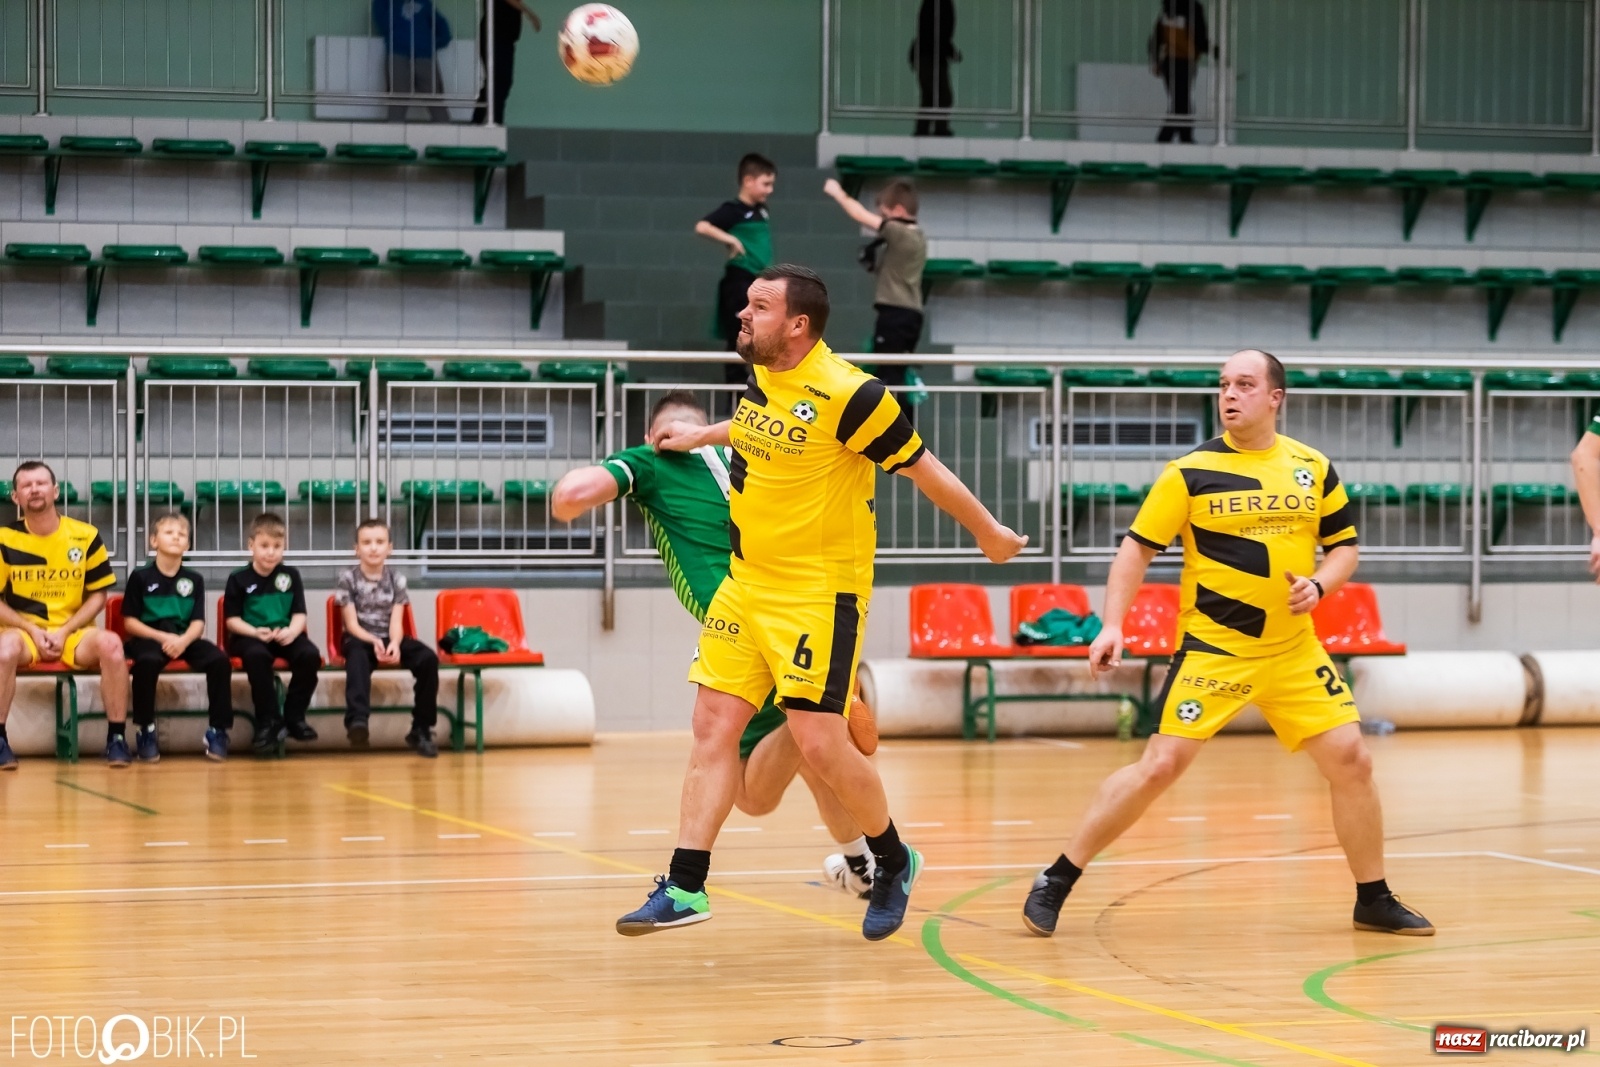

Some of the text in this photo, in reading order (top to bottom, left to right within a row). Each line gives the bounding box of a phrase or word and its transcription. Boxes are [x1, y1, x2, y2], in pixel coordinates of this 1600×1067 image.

[804, 385, 831, 401] regio
[734, 405, 808, 443] ERZOG
[745, 431, 804, 456] Agencja Pracy
[1209, 494, 1317, 515] HERZOG
[12, 568, 82, 581] HERZOG
[792, 634, 813, 670] 6
[1180, 676, 1253, 695] HERZOG
[1315, 665, 1345, 697] 2
